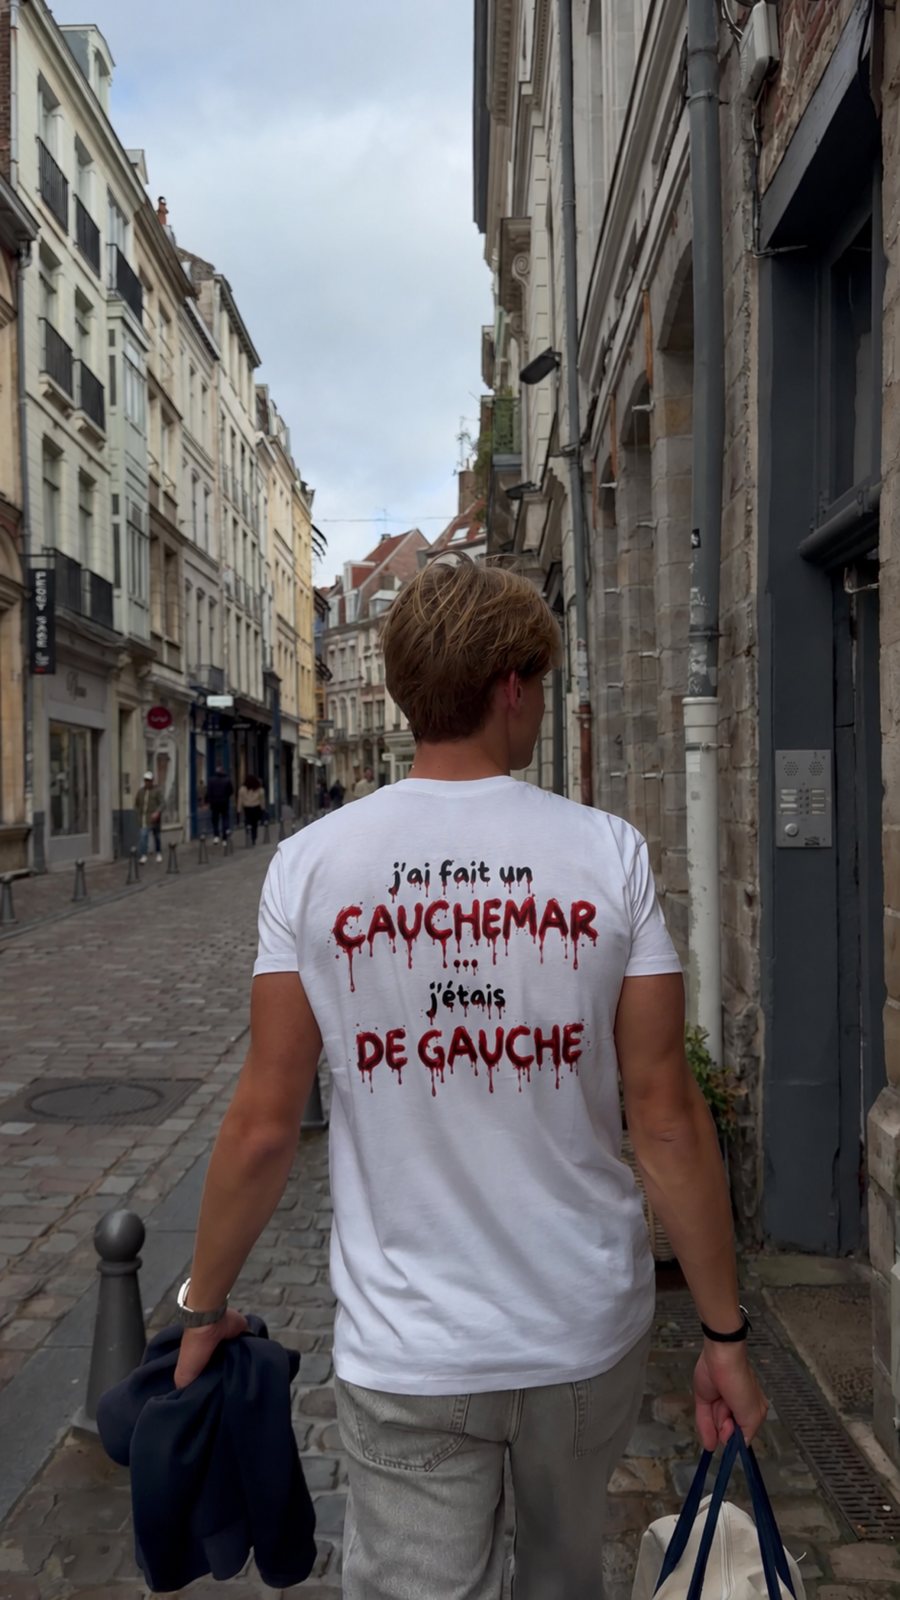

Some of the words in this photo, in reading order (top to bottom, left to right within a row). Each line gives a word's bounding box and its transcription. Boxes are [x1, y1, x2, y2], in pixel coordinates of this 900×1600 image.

[389, 862, 430, 897] j'ai
[439, 860, 490, 890] fait
[499, 866, 533, 888] un
[332, 896, 598, 955] CAUCHEMAR
[426, 981, 505, 1020] j'étais
[356, 1028, 407, 1077] DE
[417, 1022, 584, 1080] GAUCHE
